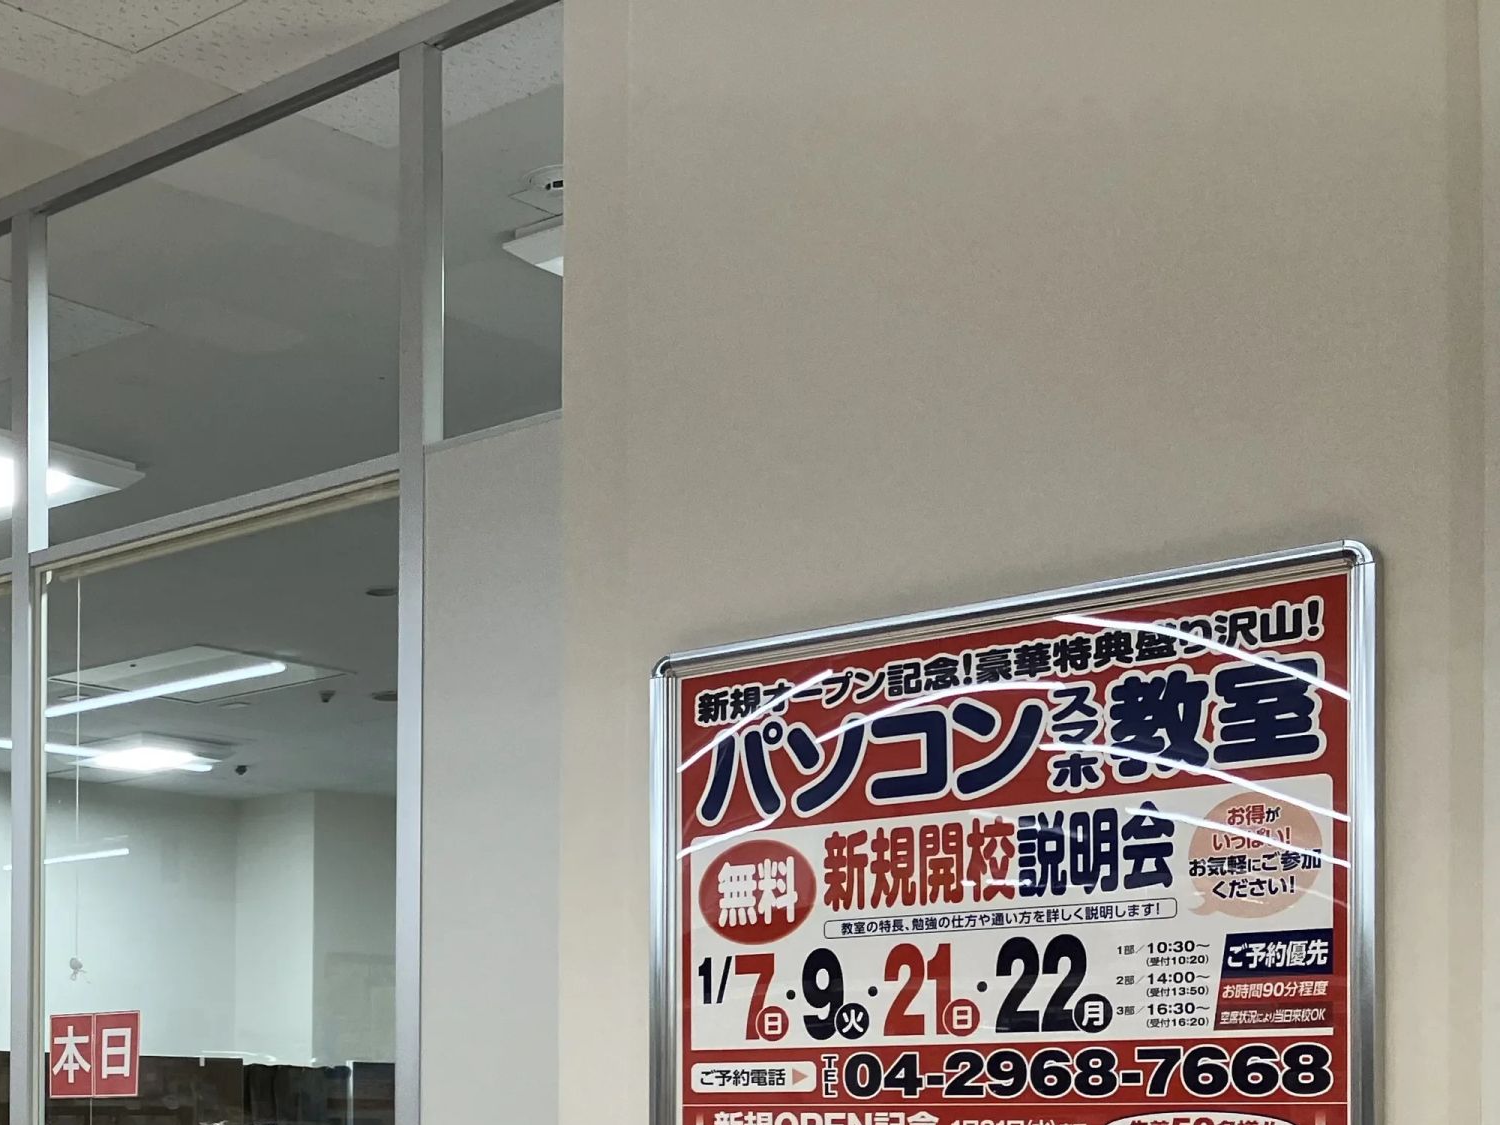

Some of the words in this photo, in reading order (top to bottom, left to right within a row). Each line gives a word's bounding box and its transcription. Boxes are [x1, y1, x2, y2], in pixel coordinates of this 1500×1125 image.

[1226, 804, 1281, 827] お得が
[823, 800, 1175, 912] 新規開校説明会
[718, 855, 798, 928] 無料
[1212, 875, 1295, 899] ください!
[1145, 954, 1210, 967] (受付10:20)
[1226, 938, 1329, 969] ご予約優先
[1145, 986, 1210, 998] (受付13:50)
[1221, 980, 1330, 1000] お時間90分程度
[1145, 1017, 1210, 1029] (受付16:20)
[51, 1024, 133, 1084] 本日
[700, 1067, 786, 1087] ご予約電話
[844, 1042, 1333, 1099] 04-2968-7668
